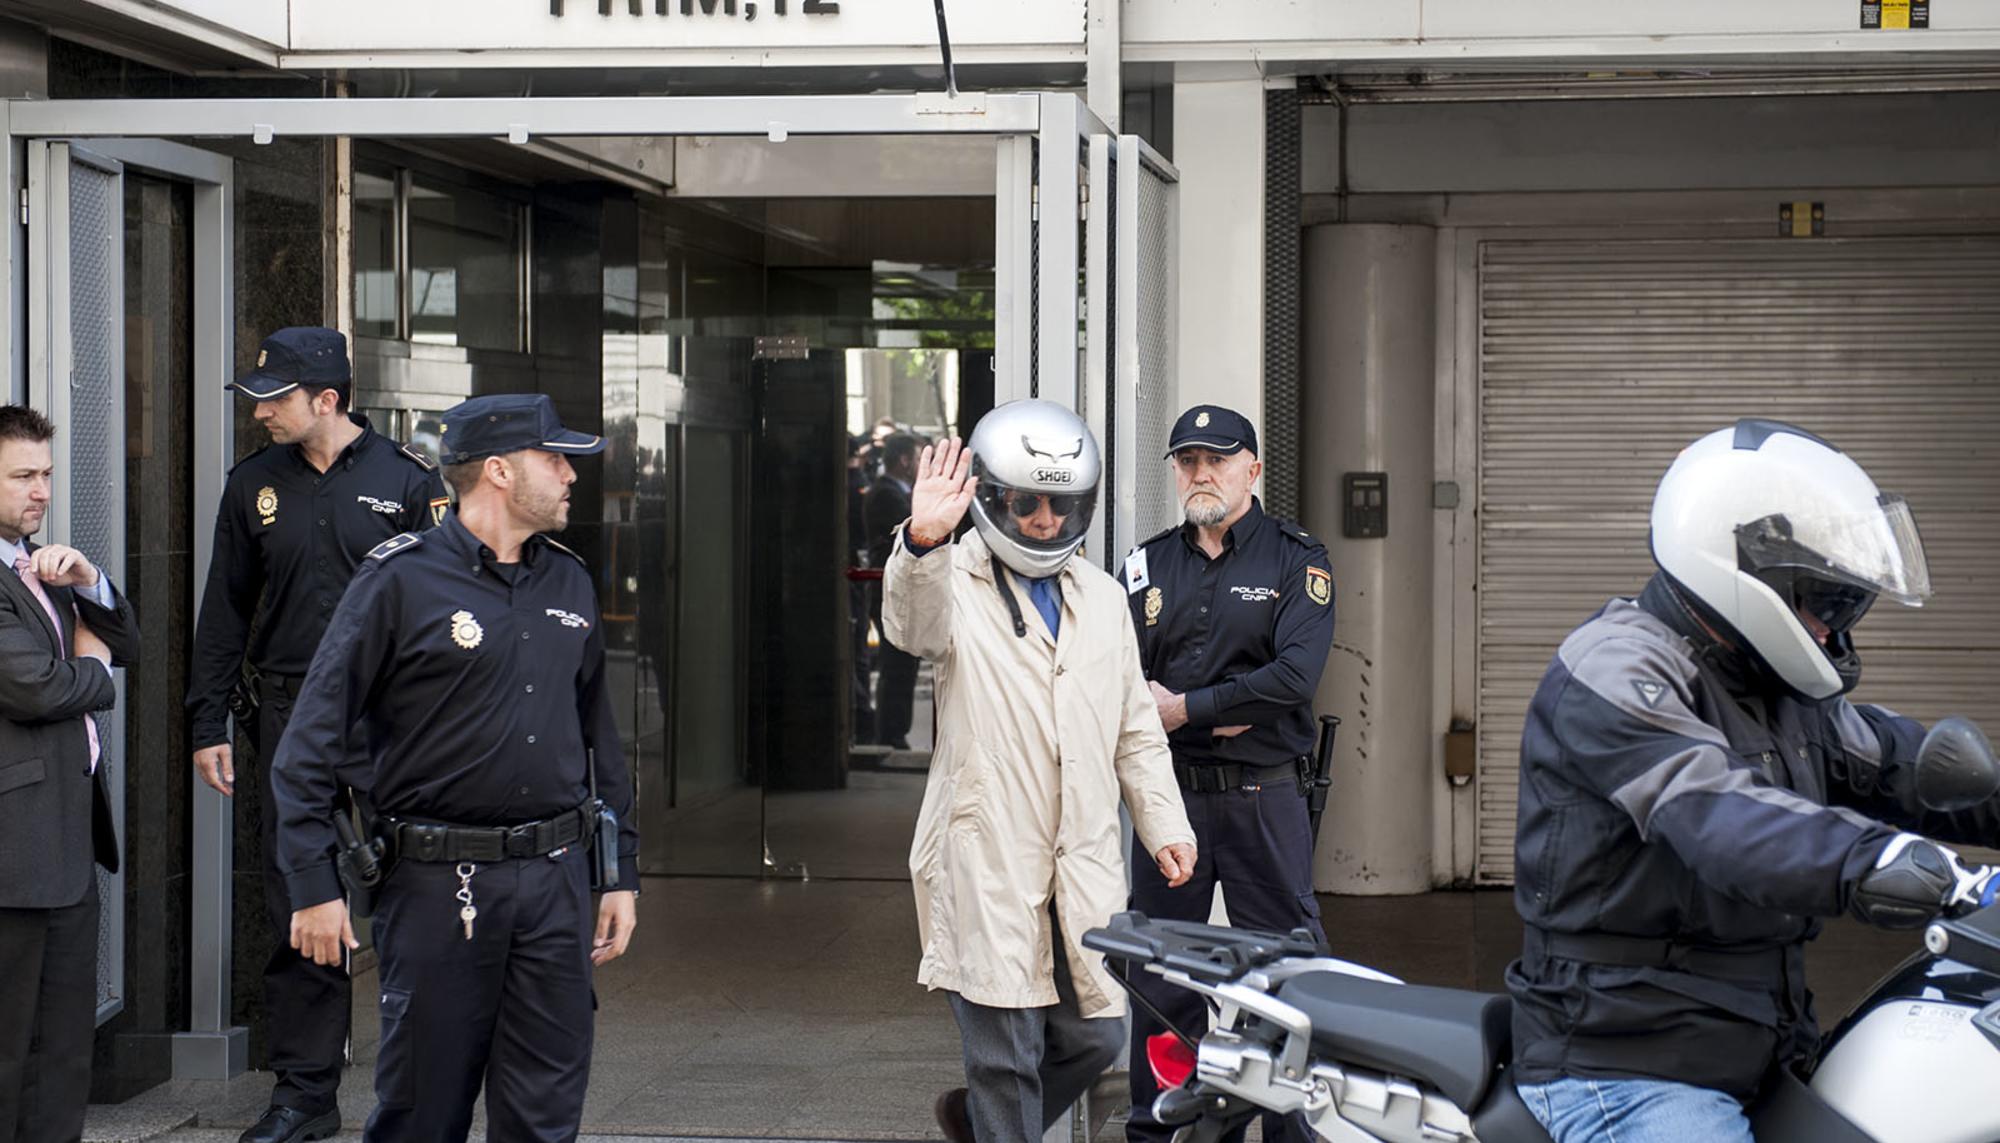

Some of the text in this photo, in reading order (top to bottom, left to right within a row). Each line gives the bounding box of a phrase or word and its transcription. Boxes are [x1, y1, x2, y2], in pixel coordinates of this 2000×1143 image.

[1037, 470, 1072, 483] SHOEI
[371, 504, 396, 514] CNP
[1230, 586, 1275, 597] POLICIA
